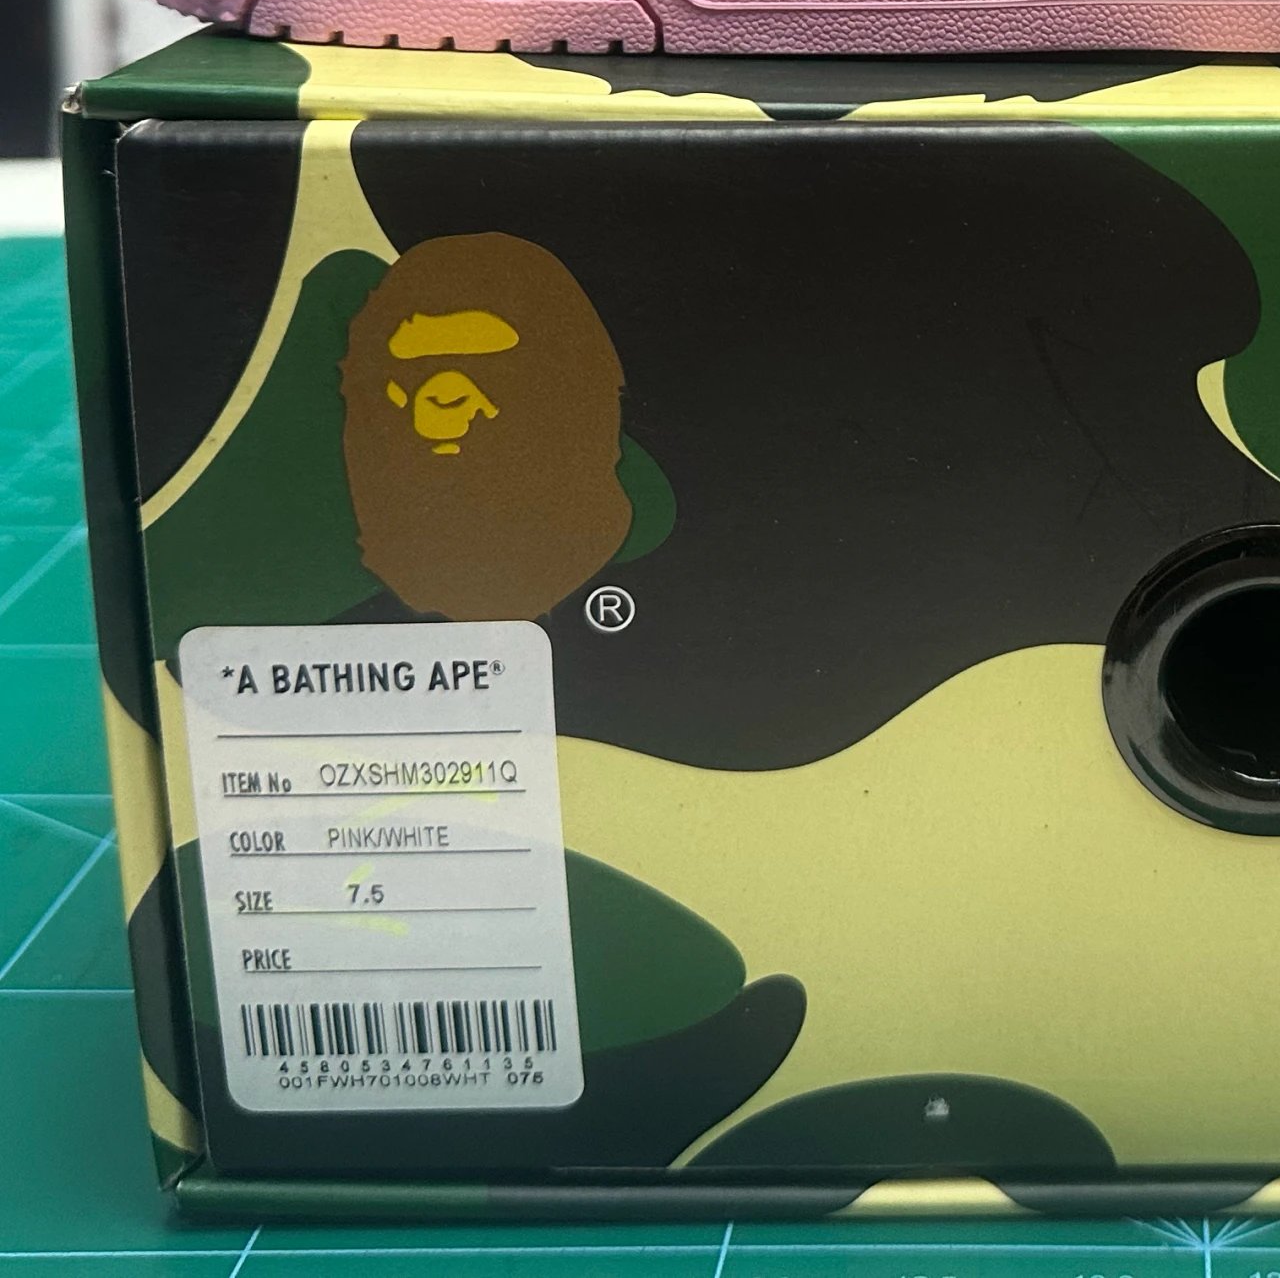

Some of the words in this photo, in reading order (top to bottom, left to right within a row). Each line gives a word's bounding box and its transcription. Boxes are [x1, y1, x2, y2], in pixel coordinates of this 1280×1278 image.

[273, 661, 416, 694] BATHING
[222, 772, 262, 794] ITEM
[269, 773, 292, 793] No
[319, 759, 518, 786] OZXSHM302911Q
[230, 831, 286, 852] COLOR
[327, 826, 450, 849] PINK/WHITE
[235, 890, 274, 913] SIZE
[347, 883, 385, 905] 7.5
[242, 949, 292, 972] PRICE
